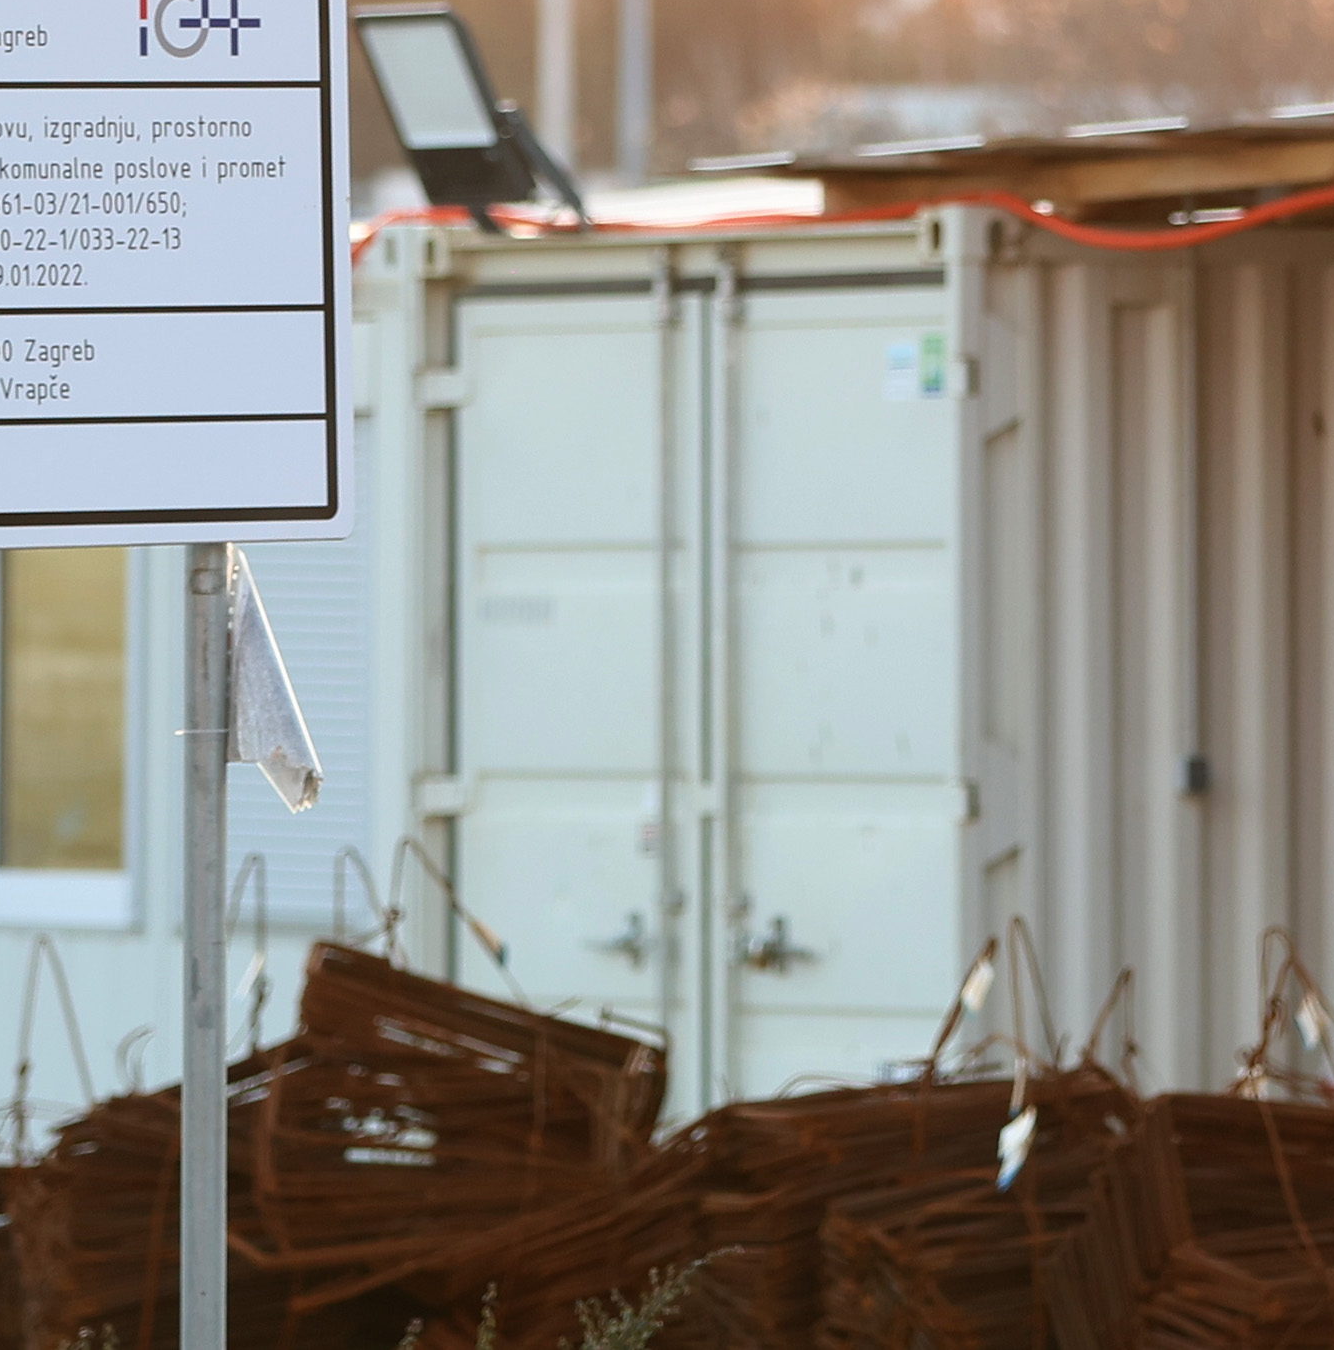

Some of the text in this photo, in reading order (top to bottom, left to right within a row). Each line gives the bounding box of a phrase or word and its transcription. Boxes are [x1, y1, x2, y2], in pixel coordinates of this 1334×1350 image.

[44, 115, 141, 145] izgradnju,
[151, 115, 252, 144] prostorno
[114, 156, 191, 185] poslove
[202, 156, 207, 178] i
[217, 155, 286, 184] promet
[24, 338, 95, 368] Zagreb
[0, 374, 71, 406] Vrapče
